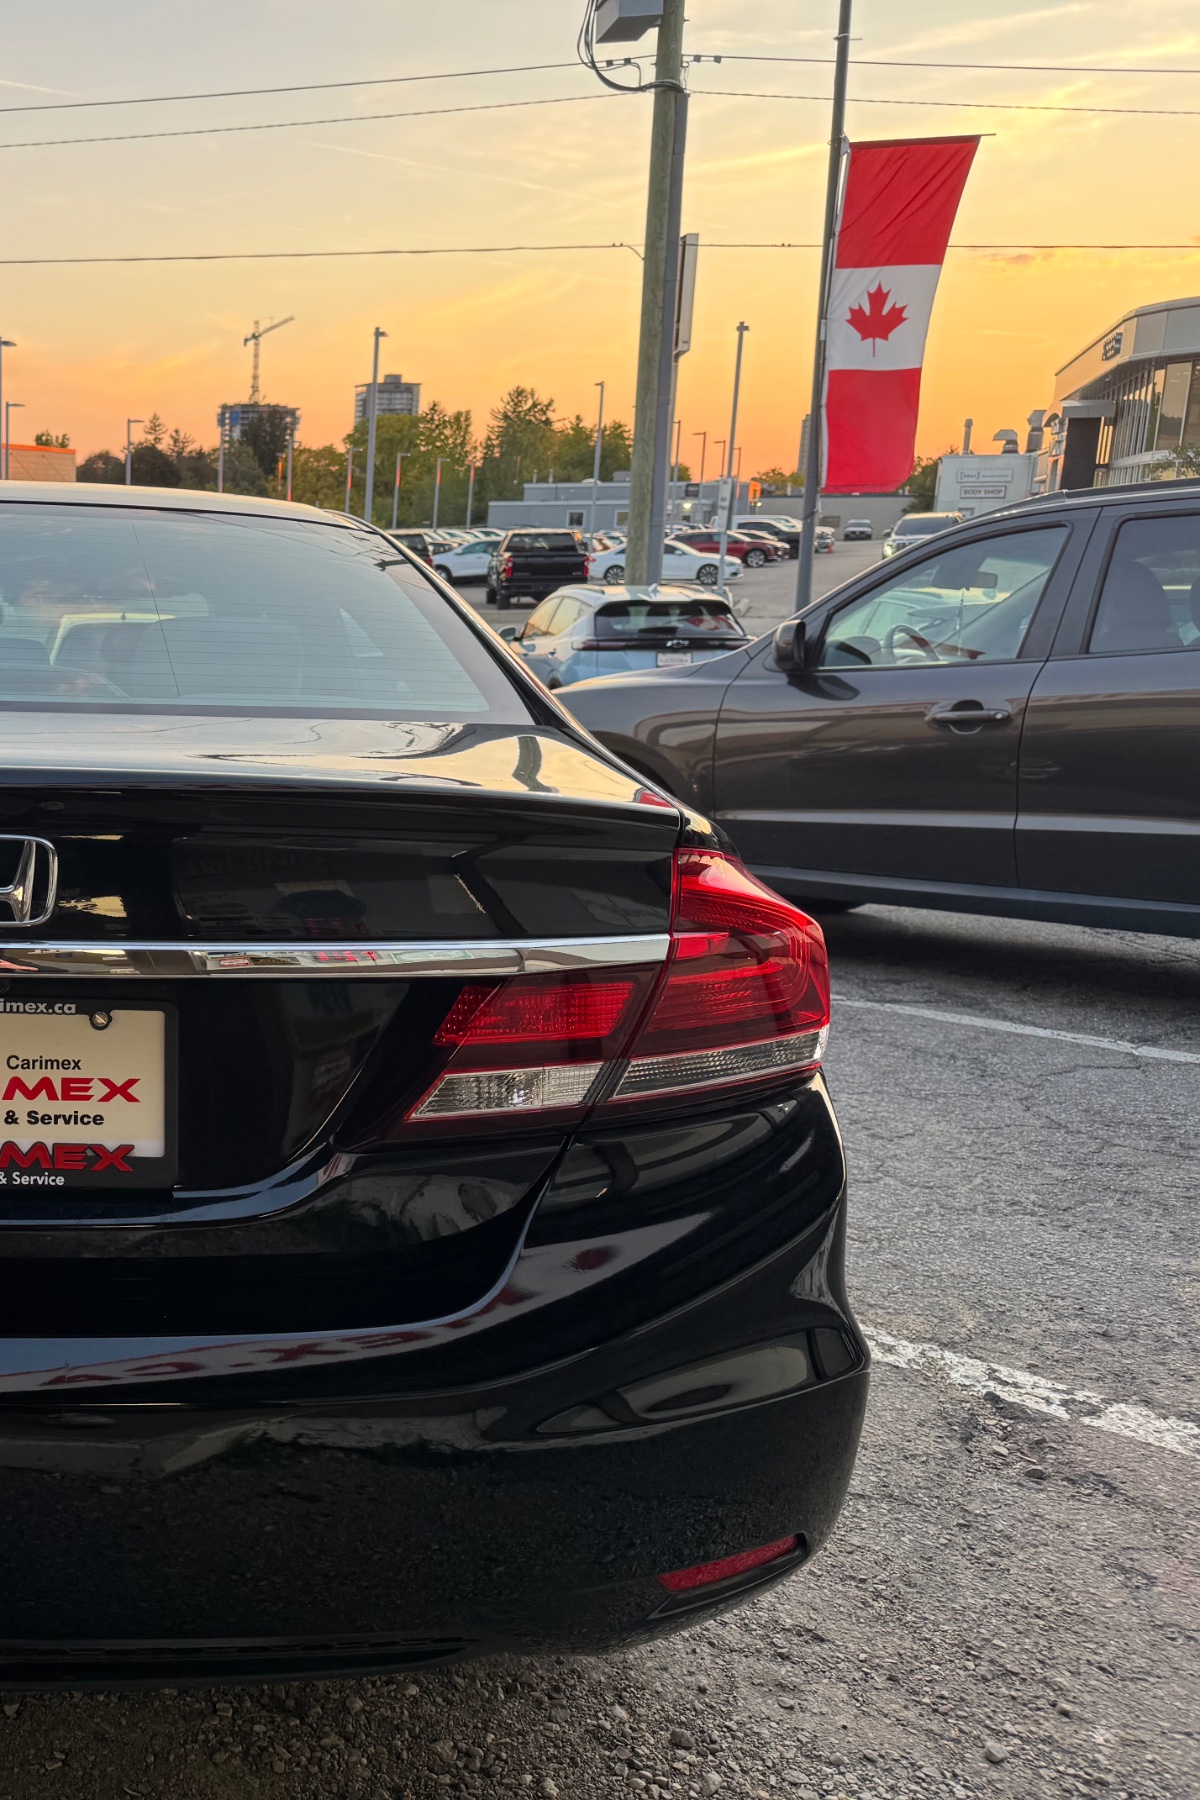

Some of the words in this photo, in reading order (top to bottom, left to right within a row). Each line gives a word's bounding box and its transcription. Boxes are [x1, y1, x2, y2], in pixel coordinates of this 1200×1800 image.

[6, 1056, 82, 1071] Carimex
[3, 1110, 19, 1125] &
[26, 1110, 105, 1126] Service
[12, 1172, 65, 1186] Service
